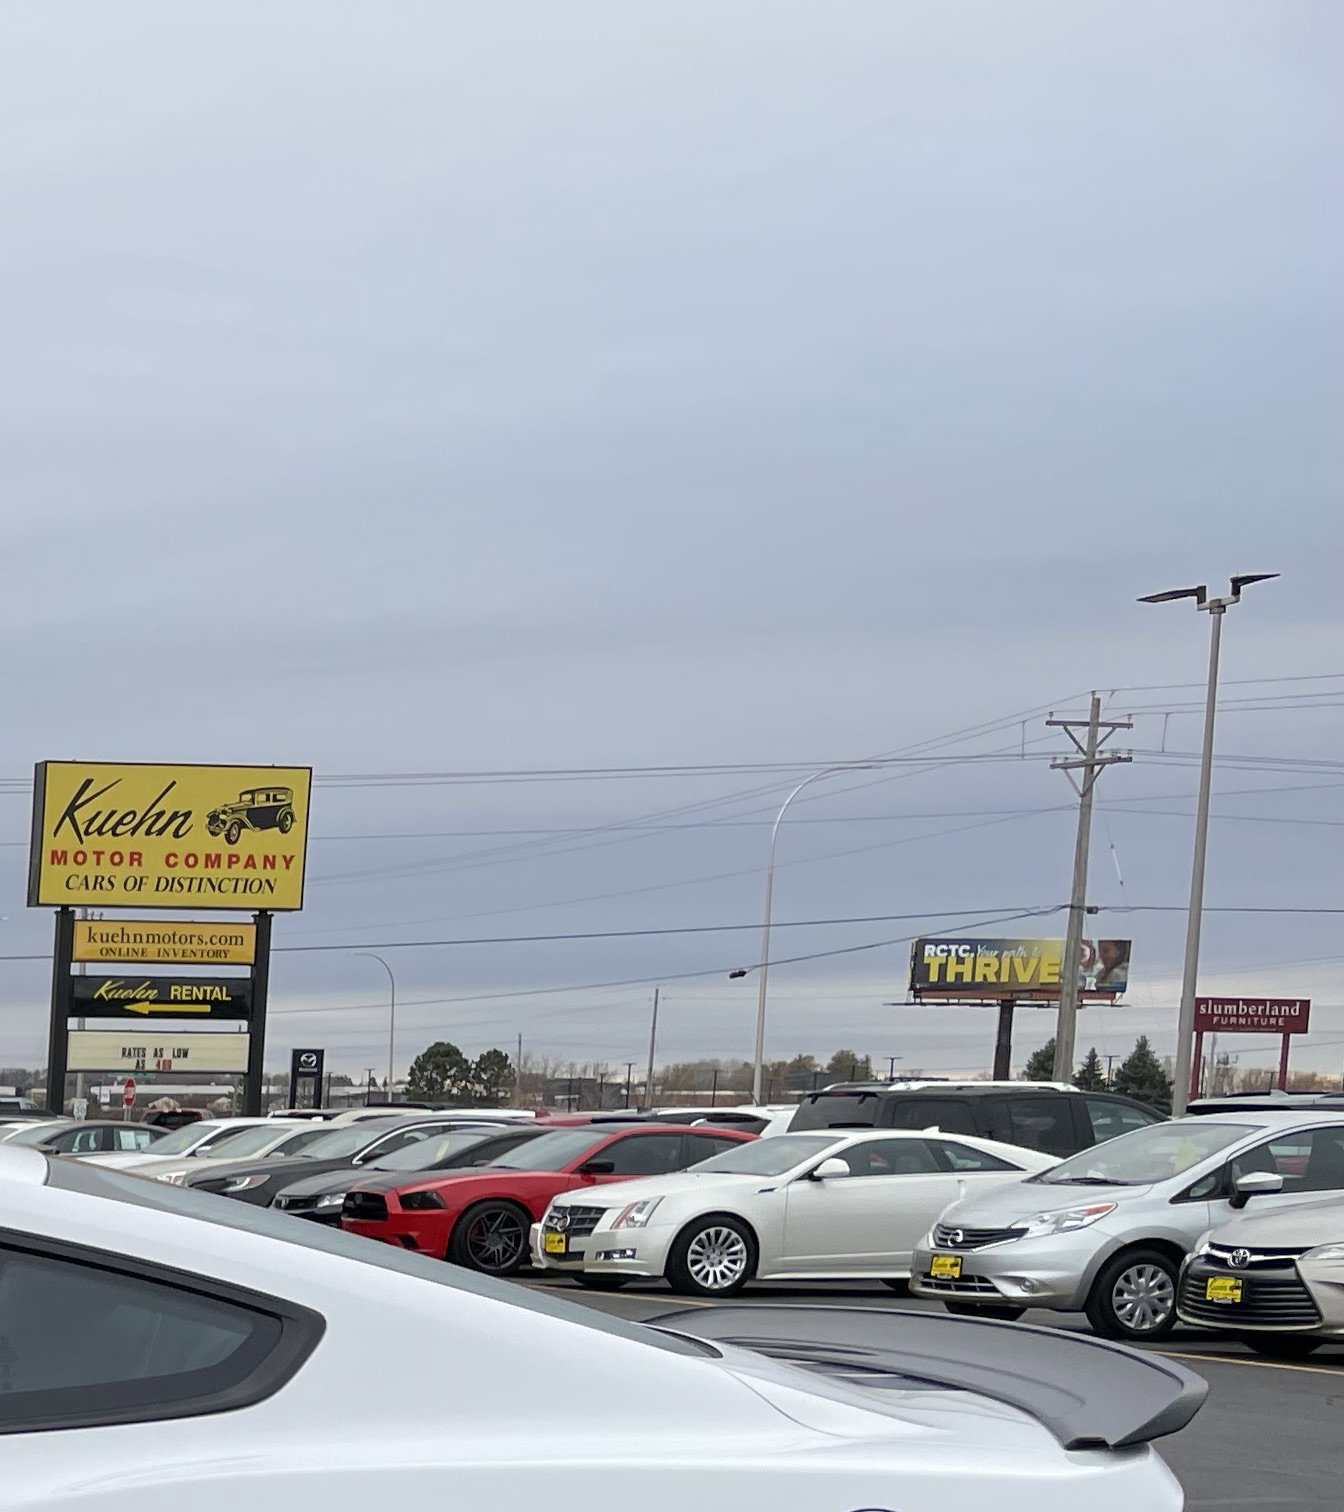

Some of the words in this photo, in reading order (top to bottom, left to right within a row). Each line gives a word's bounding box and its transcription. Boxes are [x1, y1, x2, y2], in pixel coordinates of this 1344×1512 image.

[53, 778, 193, 845] Kuehn
[50, 850, 144, 867] MOTOR
[164, 852, 297, 870] COMPANY
[65, 874, 115, 892] CARS
[123, 875, 149, 892] OF
[155, 876, 277, 894] DISTINCTION
[87, 926, 244, 946] kuehnmotors.com
[99, 947, 148, 958] ONLINE
[157, 948, 231, 959] INVENTORY
[93, 980, 159, 1000] Kuehn
[170, 985, 231, 1001] RENTAL
[1199, 1000, 1300, 1016] slumberland
[1213, 1016, 1285, 1026] FURNITURE
[121, 1047, 146, 1058] RATES
[153, 1047, 164, 1058] AS
[172, 1047, 189, 1058] LOW
[135, 1059, 146, 1070] AS
